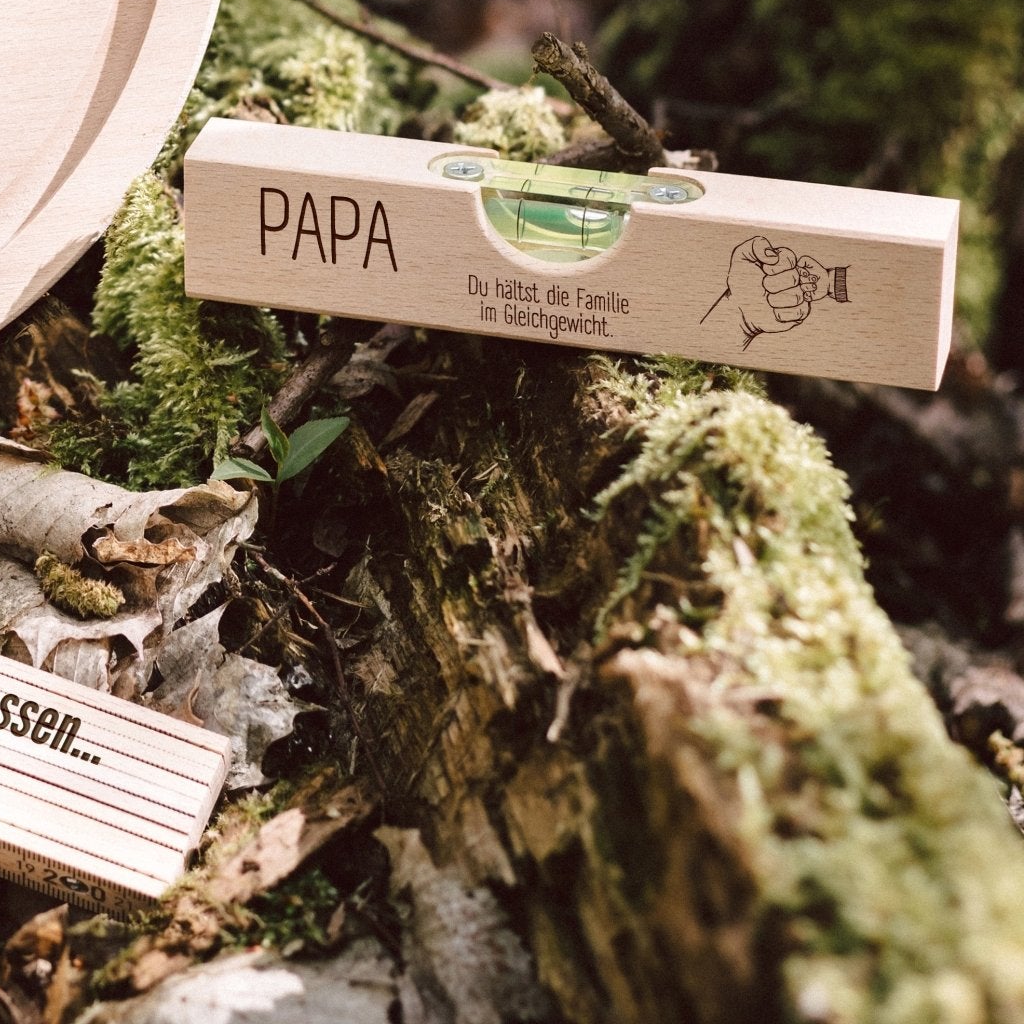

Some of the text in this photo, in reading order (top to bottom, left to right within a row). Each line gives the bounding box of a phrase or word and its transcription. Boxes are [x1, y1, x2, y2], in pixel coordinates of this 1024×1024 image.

[259, 187, 398, 272] PAPA
[468, 274, 630, 314] Du hältst die Familie
[480, 301, 614, 339] im Gleichgewicht.
[16, 860, 35, 873] 19
